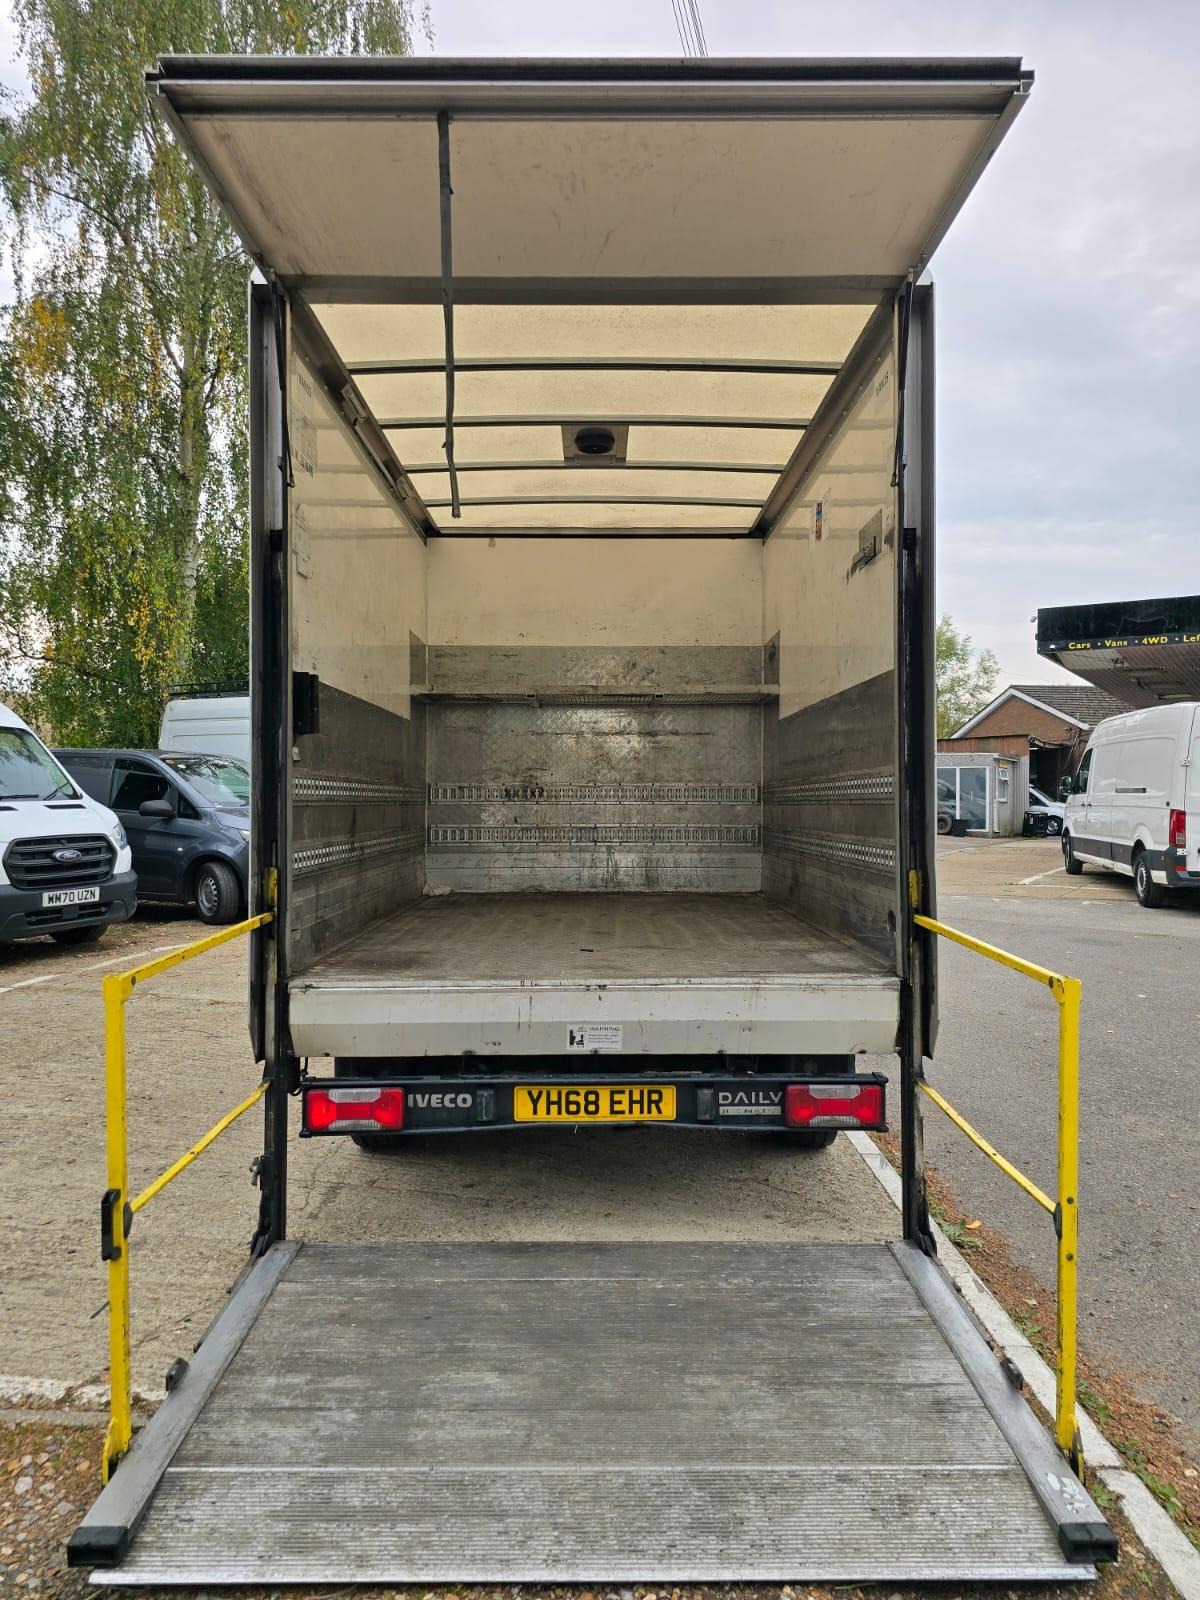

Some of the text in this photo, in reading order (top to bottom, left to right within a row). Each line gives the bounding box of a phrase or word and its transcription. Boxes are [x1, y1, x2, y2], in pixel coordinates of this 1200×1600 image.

[1142, 636, 1169, 645] 4WD
[77, 888, 96, 901] UZN
[407, 1093, 473, 1108] IVECO
[527, 1089, 664, 1116] YH68 EHR
[719, 1091, 782, 1104] DAILY
